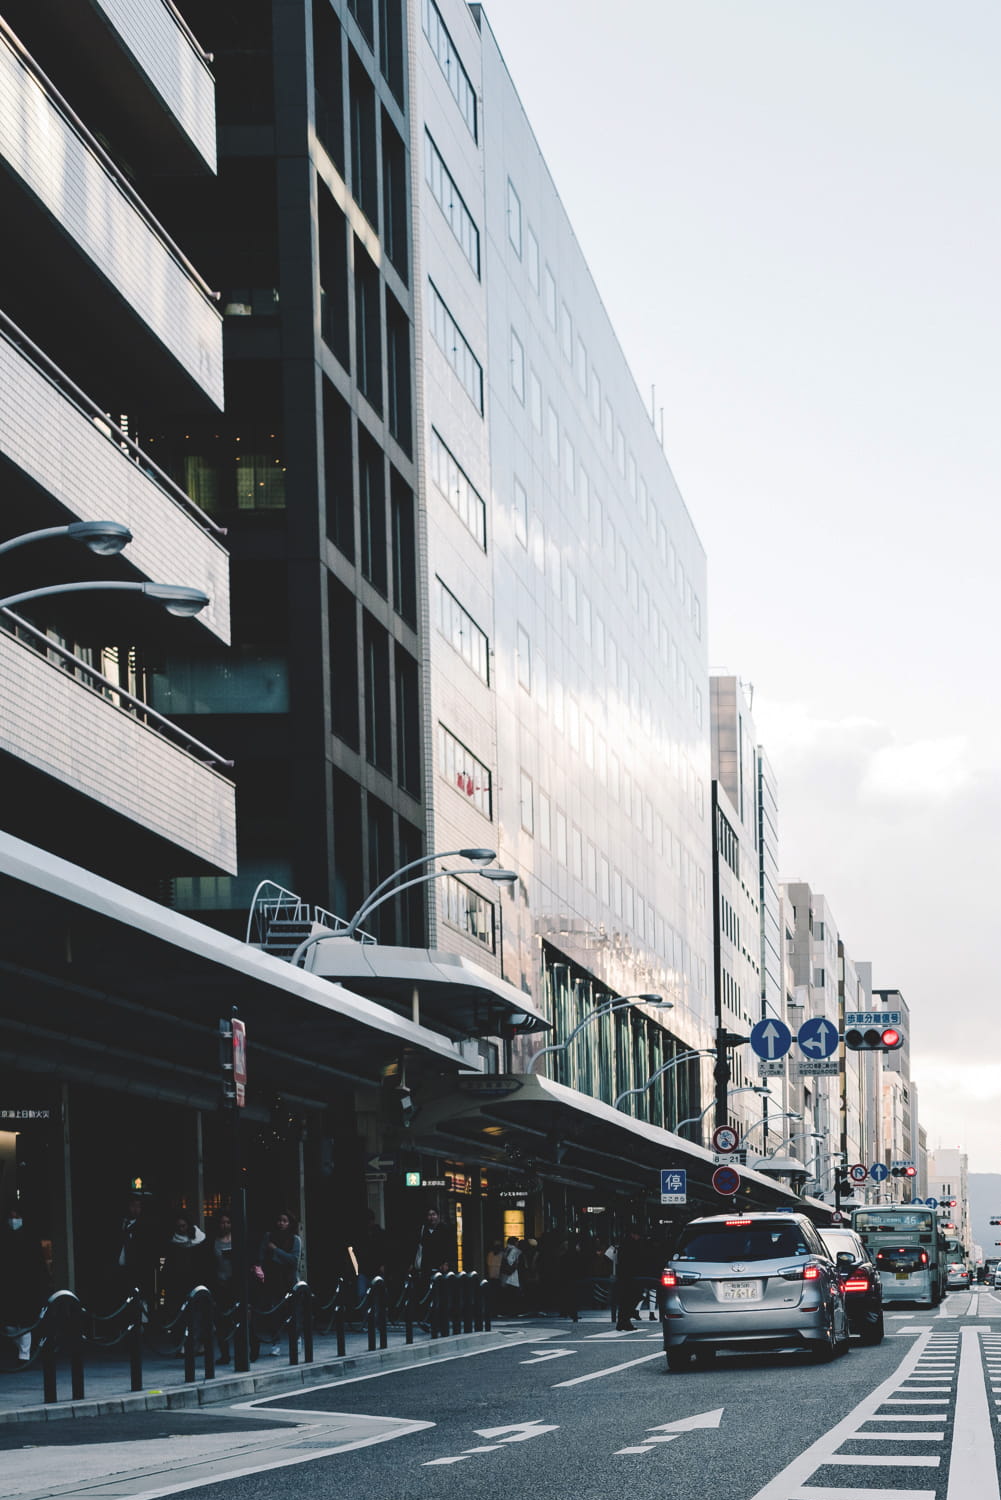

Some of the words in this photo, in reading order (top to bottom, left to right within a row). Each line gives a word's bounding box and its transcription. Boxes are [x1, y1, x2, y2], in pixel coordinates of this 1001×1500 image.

[847, 1013, 899, 1024] 歩車分離信号
[665, 1174, 682, 1191] 停
[903, 1216, 917, 1225] 46
